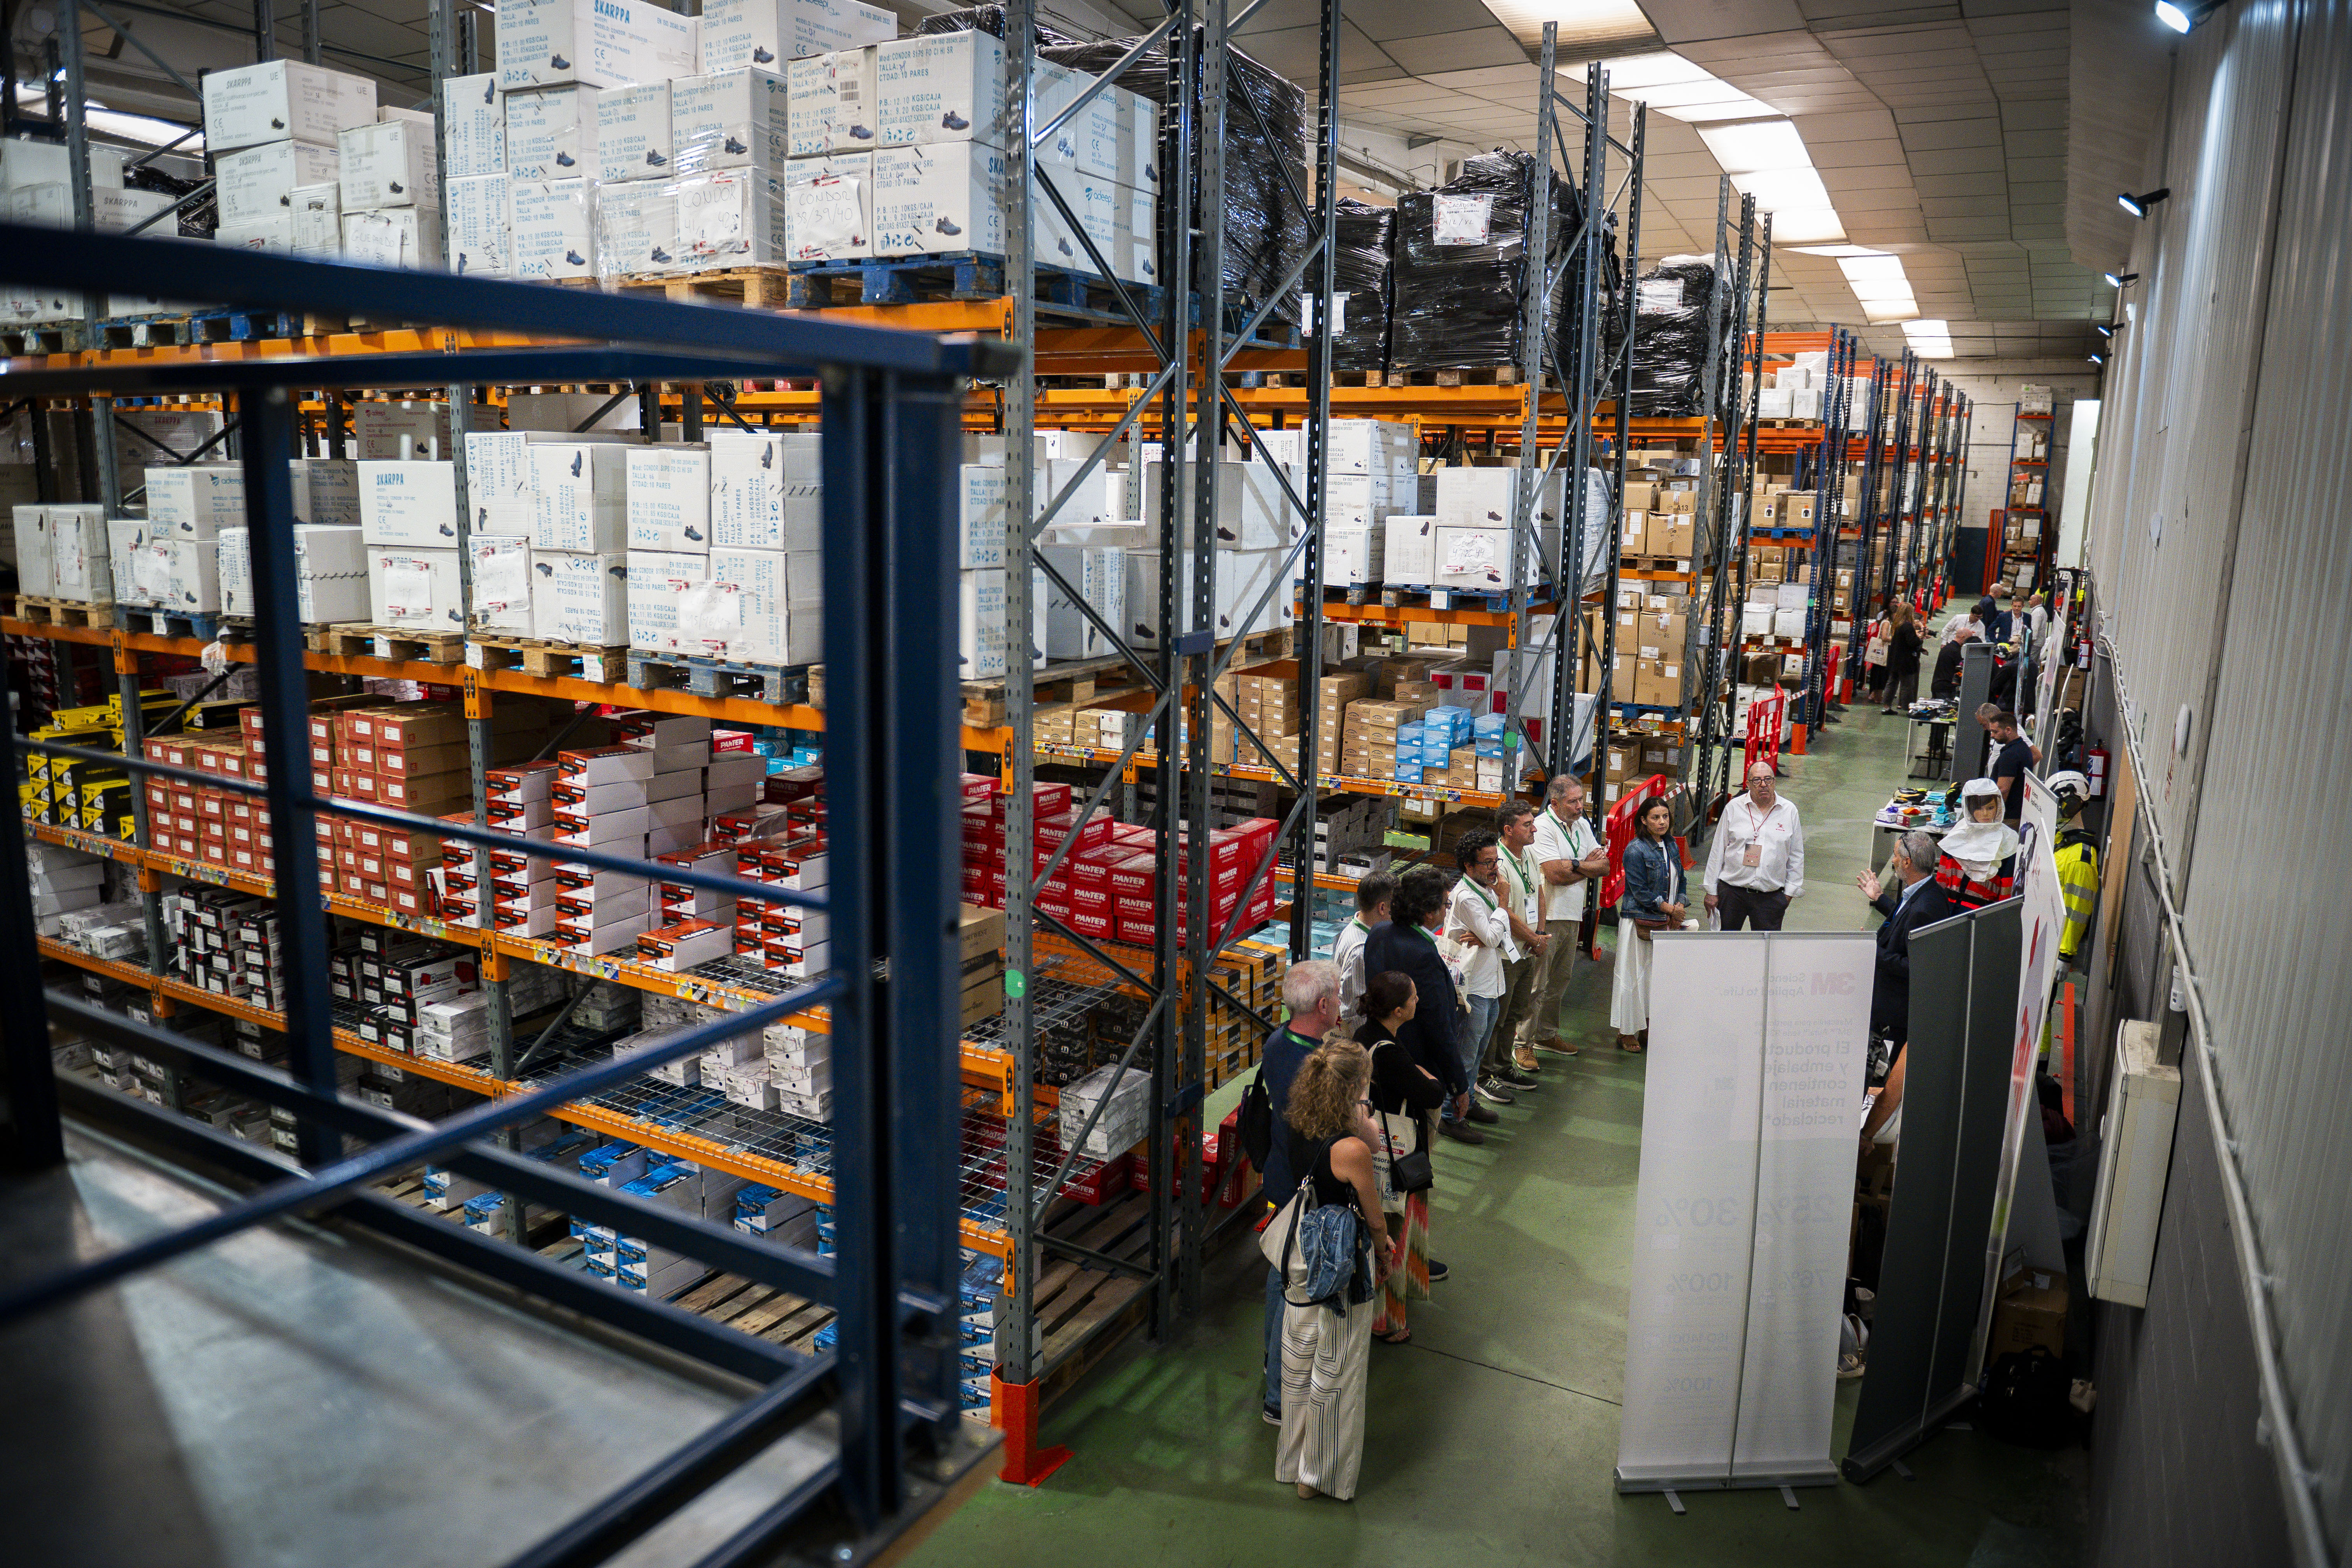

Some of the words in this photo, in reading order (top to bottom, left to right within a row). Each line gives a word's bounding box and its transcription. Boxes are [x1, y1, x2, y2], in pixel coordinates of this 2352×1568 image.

[594, 0, 630, 24] SKARPPA
[728, 14, 742, 24] PARES
[947, 46, 953, 54] SR
[879, 63, 898, 72] TALLA:
[270, 72, 278, 81] UE
[879, 72, 899, 82] CTDAD:
[910, 68, 929, 78] PARES
[226, 77, 252, 89] SKARPPA
[357, 86, 368, 95] UE
[912, 93, 941, 102] KGS/CAJA
[912, 103, 940, 112] KGS/CAJA
[389, 132, 398, 141] UE
[238, 154, 261, 167] SKARPPA
[279, 150, 287, 159] UE
[877, 155, 895, 164] ADEEPI
[786, 163, 805, 172] ADEEPI
[890, 162, 910, 171] CONDOR
[924, 159, 933, 168] SRC
[683, 184, 735, 207] CONDOR
[799, 191, 850, 205] CONDOR
[796, 203, 853, 229] 38/39/40
[376, 473, 404, 486] SKARPPA
[658, 503, 680, 511] KGS/CAJA
[657, 511, 680, 519] KGS/CAJA
[653, 604, 677, 612] KGS/CAJA
[653, 612, 676, 621] KGS/CAJA
[720, 738, 744, 749] PANTER
[968, 784, 991, 796] PANTER
[2024, 783, 2031, 801] 3M
[1039, 792, 1060, 803] PANTER
[1084, 823, 1104, 837] PANTER
[1219, 842, 1238, 855] PANTER
[1074, 863, 1105, 875] PANTER
[1219, 868, 1237, 881] PANTER
[1113, 874, 1145, 887] PANTER
[1074, 889, 1105, 901] PANTER
[1251, 900, 1268, 914] PANTER
[1075, 914, 1106, 926] PANTER
[1264, 963, 1277, 973] mendi
[1228, 980, 1240, 991] mendi
[1228, 1032, 1240, 1044] mendi
[1228, 1059, 1240, 1070] mendi
[1065, 1182, 1094, 1196] PANTER
